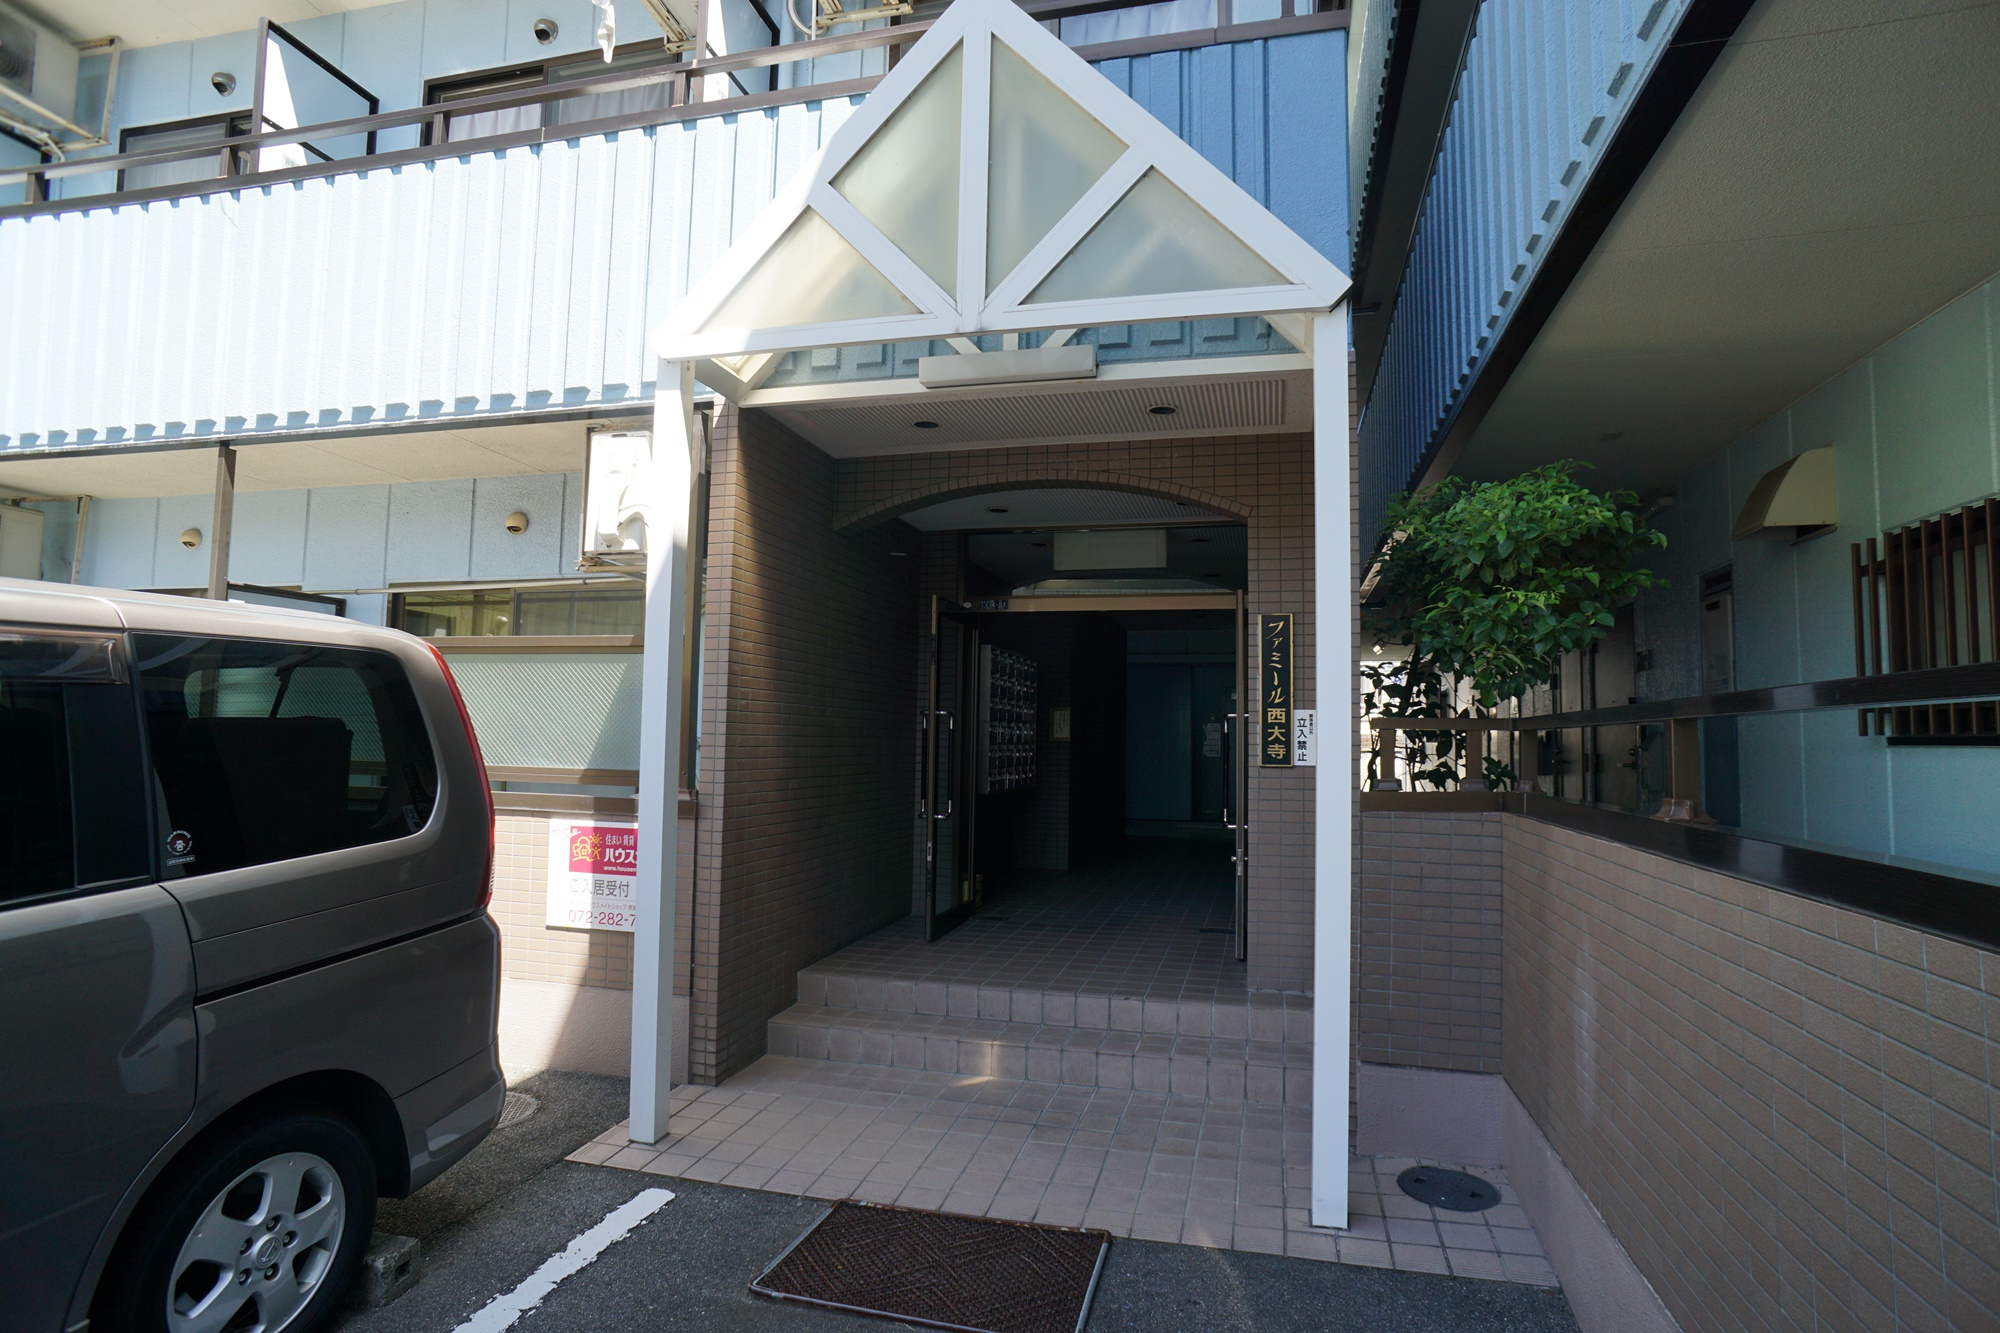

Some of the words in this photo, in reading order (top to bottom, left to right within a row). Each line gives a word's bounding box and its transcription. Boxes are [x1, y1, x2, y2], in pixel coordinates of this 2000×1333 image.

[1265, 620, 1287, 760] ファミール西大寺
[1296, 717, 1308, 762] 立入禁止
[606, 834, 622, 845] 住まい
[604, 848, 638, 863] ハウス
[568, 909, 637, 927] 072-282-7
